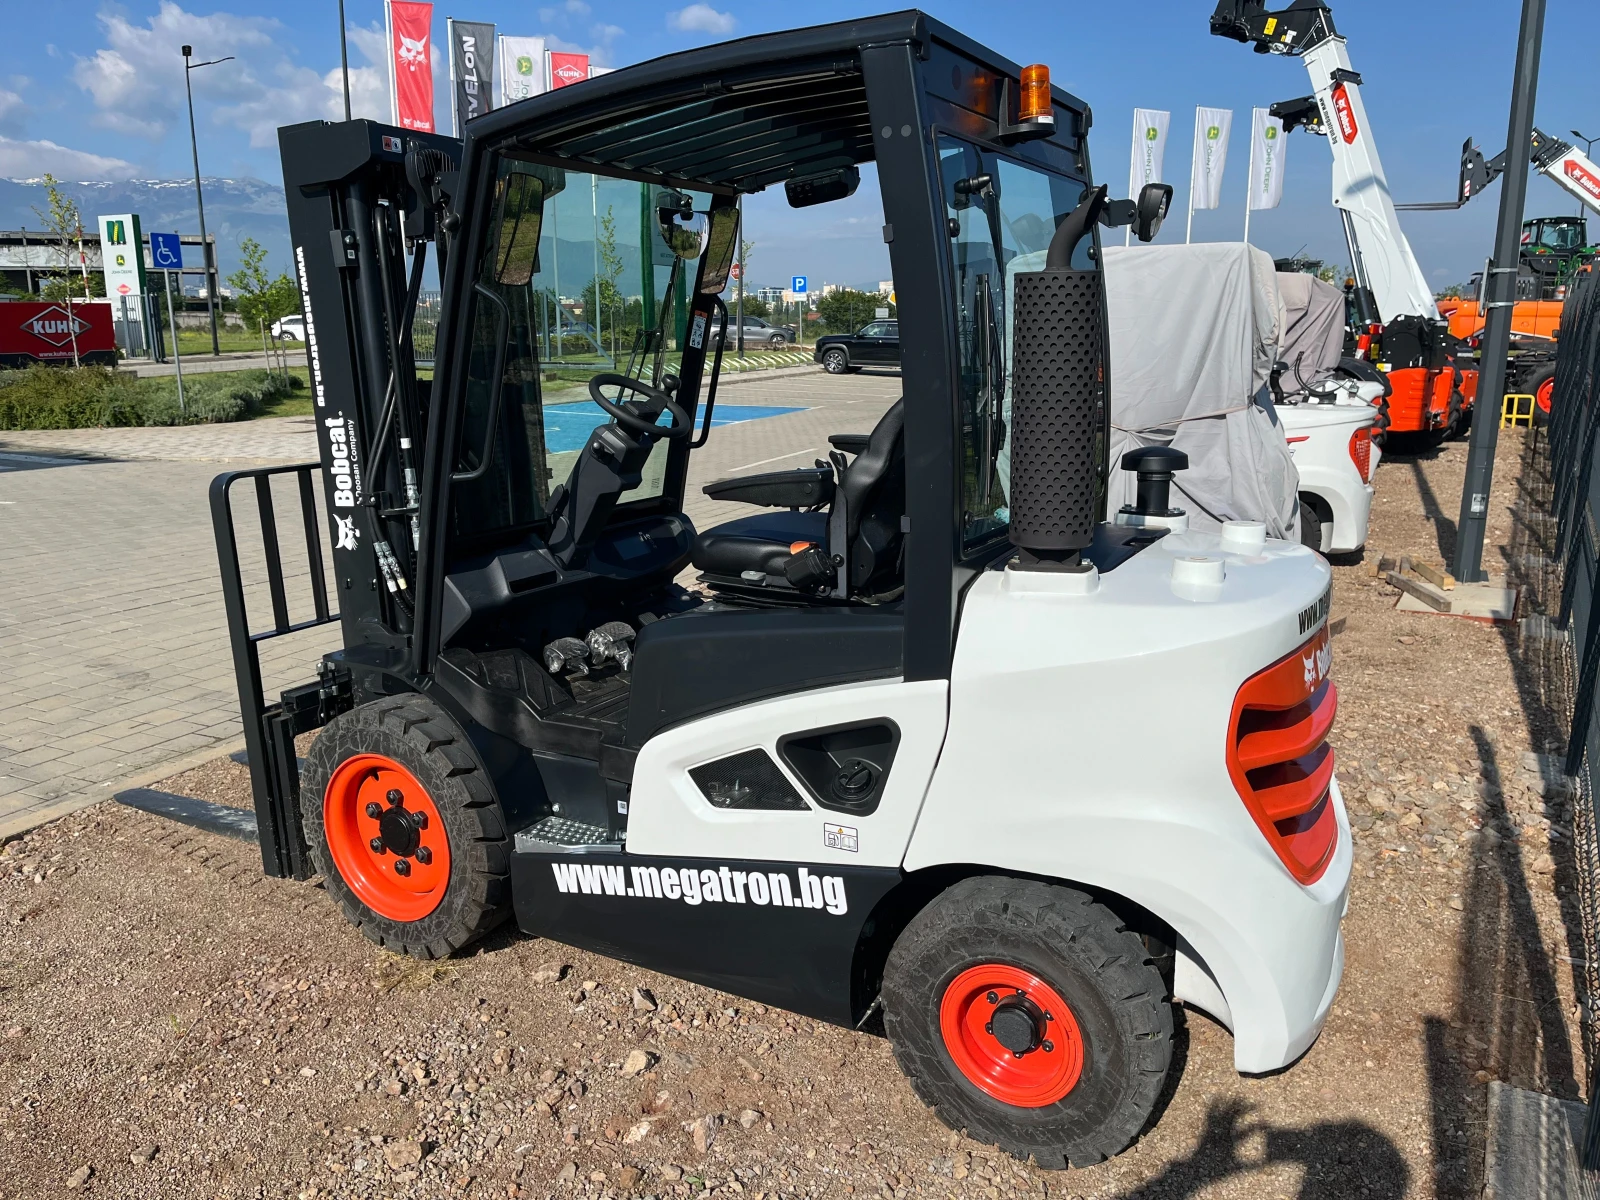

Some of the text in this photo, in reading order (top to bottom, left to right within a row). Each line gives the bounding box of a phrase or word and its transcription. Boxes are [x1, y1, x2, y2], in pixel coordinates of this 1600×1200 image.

[463, 36, 479, 119] VELON
[558, 70, 580, 78] KUHN
[1340, 110, 1352, 136] Bobcat
[1263, 166, 1271, 194] DEERE
[795, 278, 805, 291] P
[33, 320, 80, 334] KUHN
[296, 246, 326, 407] www.megatron.bg
[347, 419, 358, 462] Company
[325, 417, 355, 507] Bobcat
[551, 863, 848, 916] www.megatron.bg
